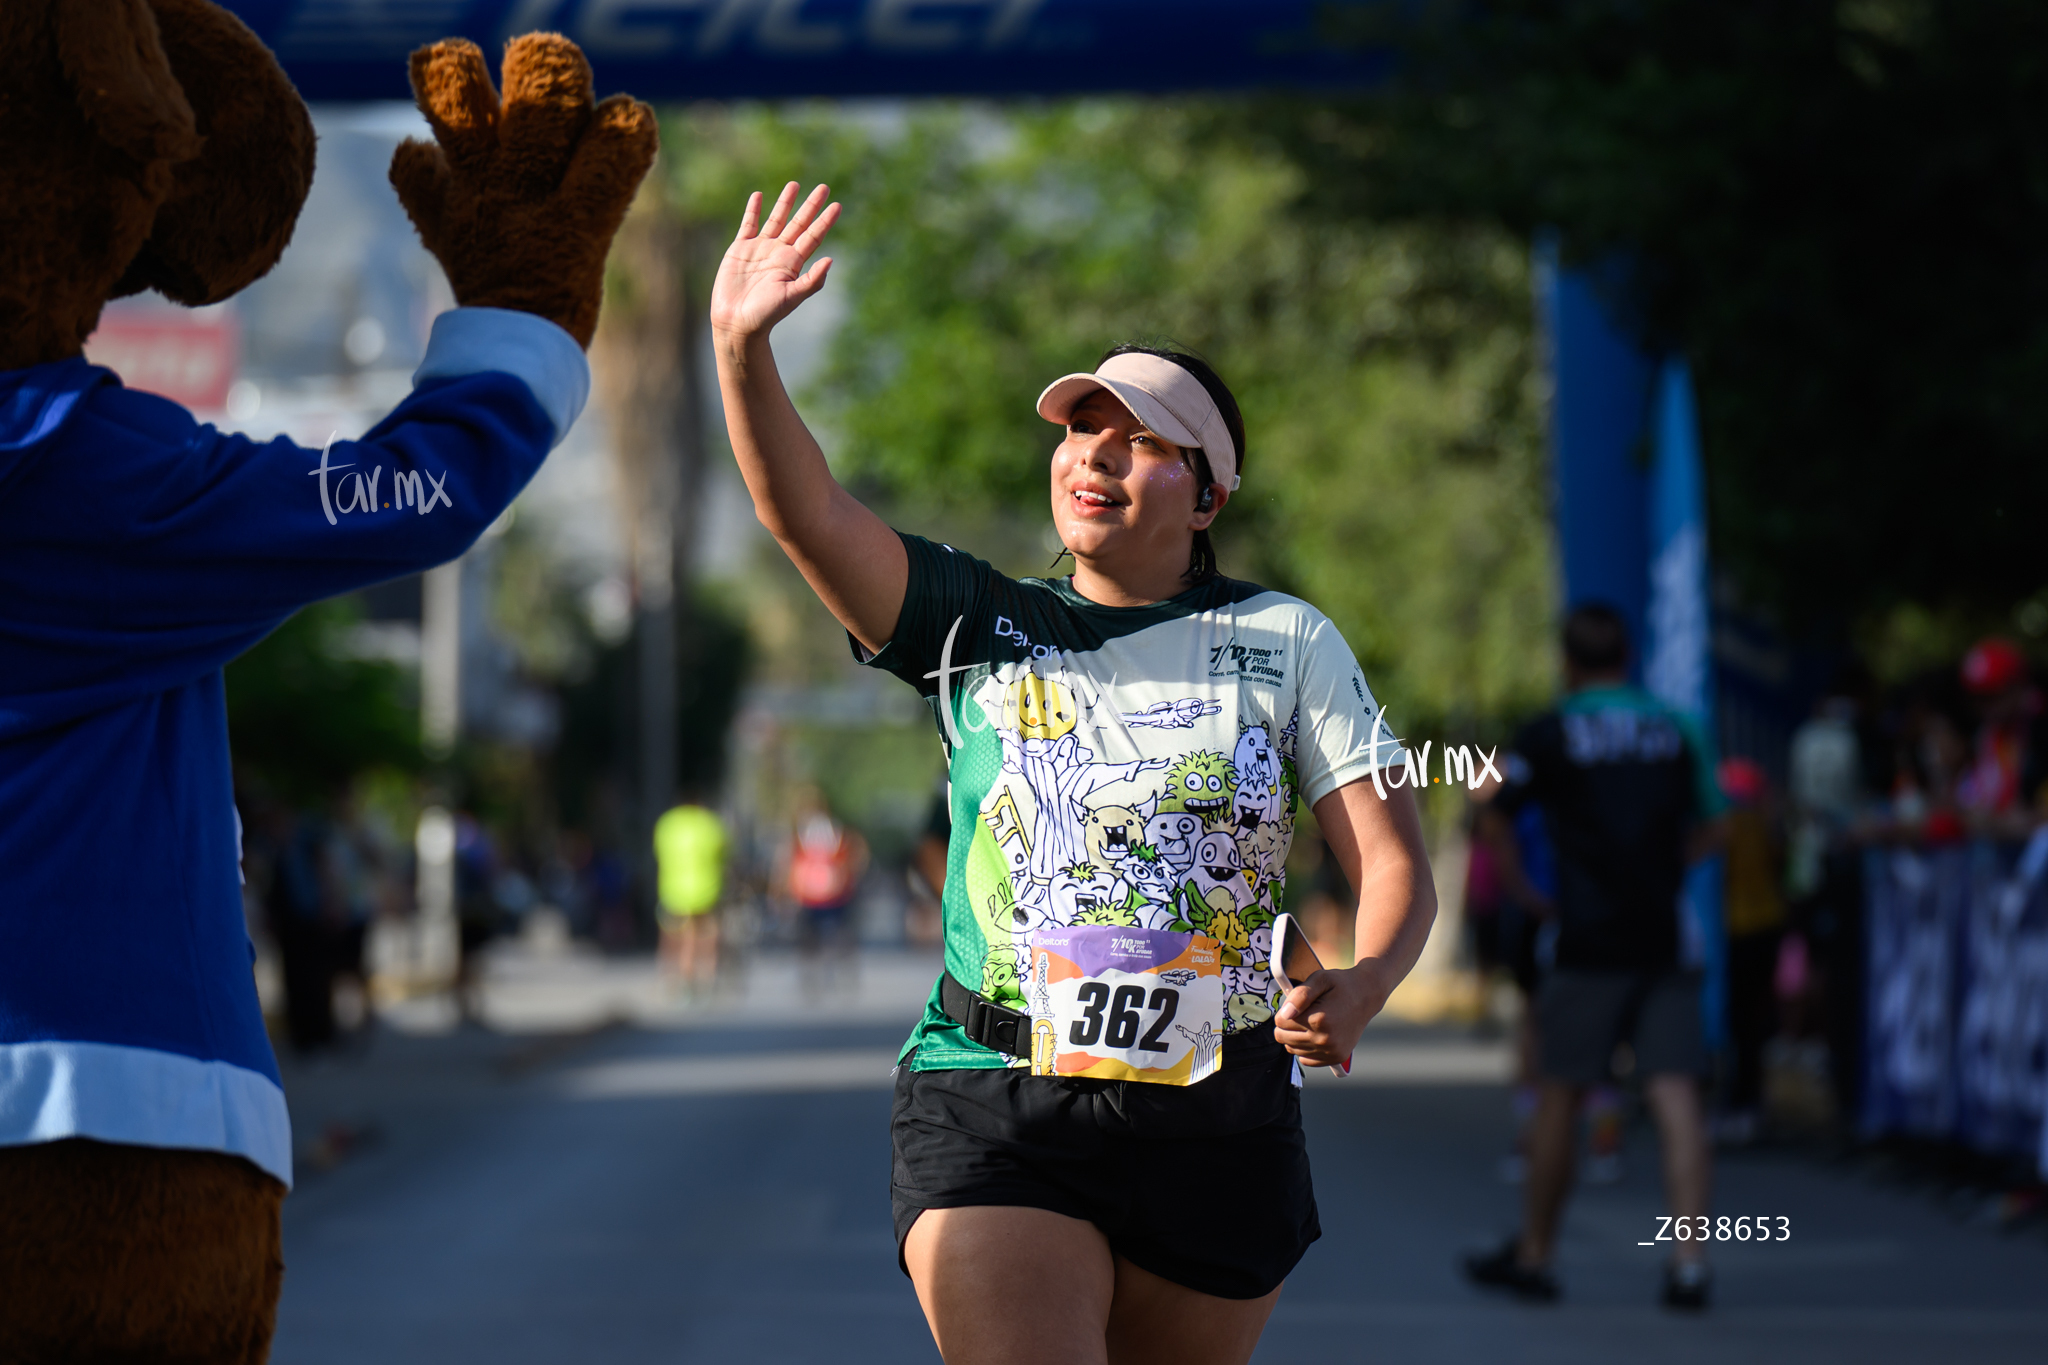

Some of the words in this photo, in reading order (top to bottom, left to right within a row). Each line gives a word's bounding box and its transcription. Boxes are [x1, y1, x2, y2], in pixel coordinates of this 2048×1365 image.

[1248, 647, 1272, 657] TODO
[1251, 657, 1270, 666] POR
[1249, 665, 1284, 679] AYUDAR
[1069, 982, 1179, 1053] 362
